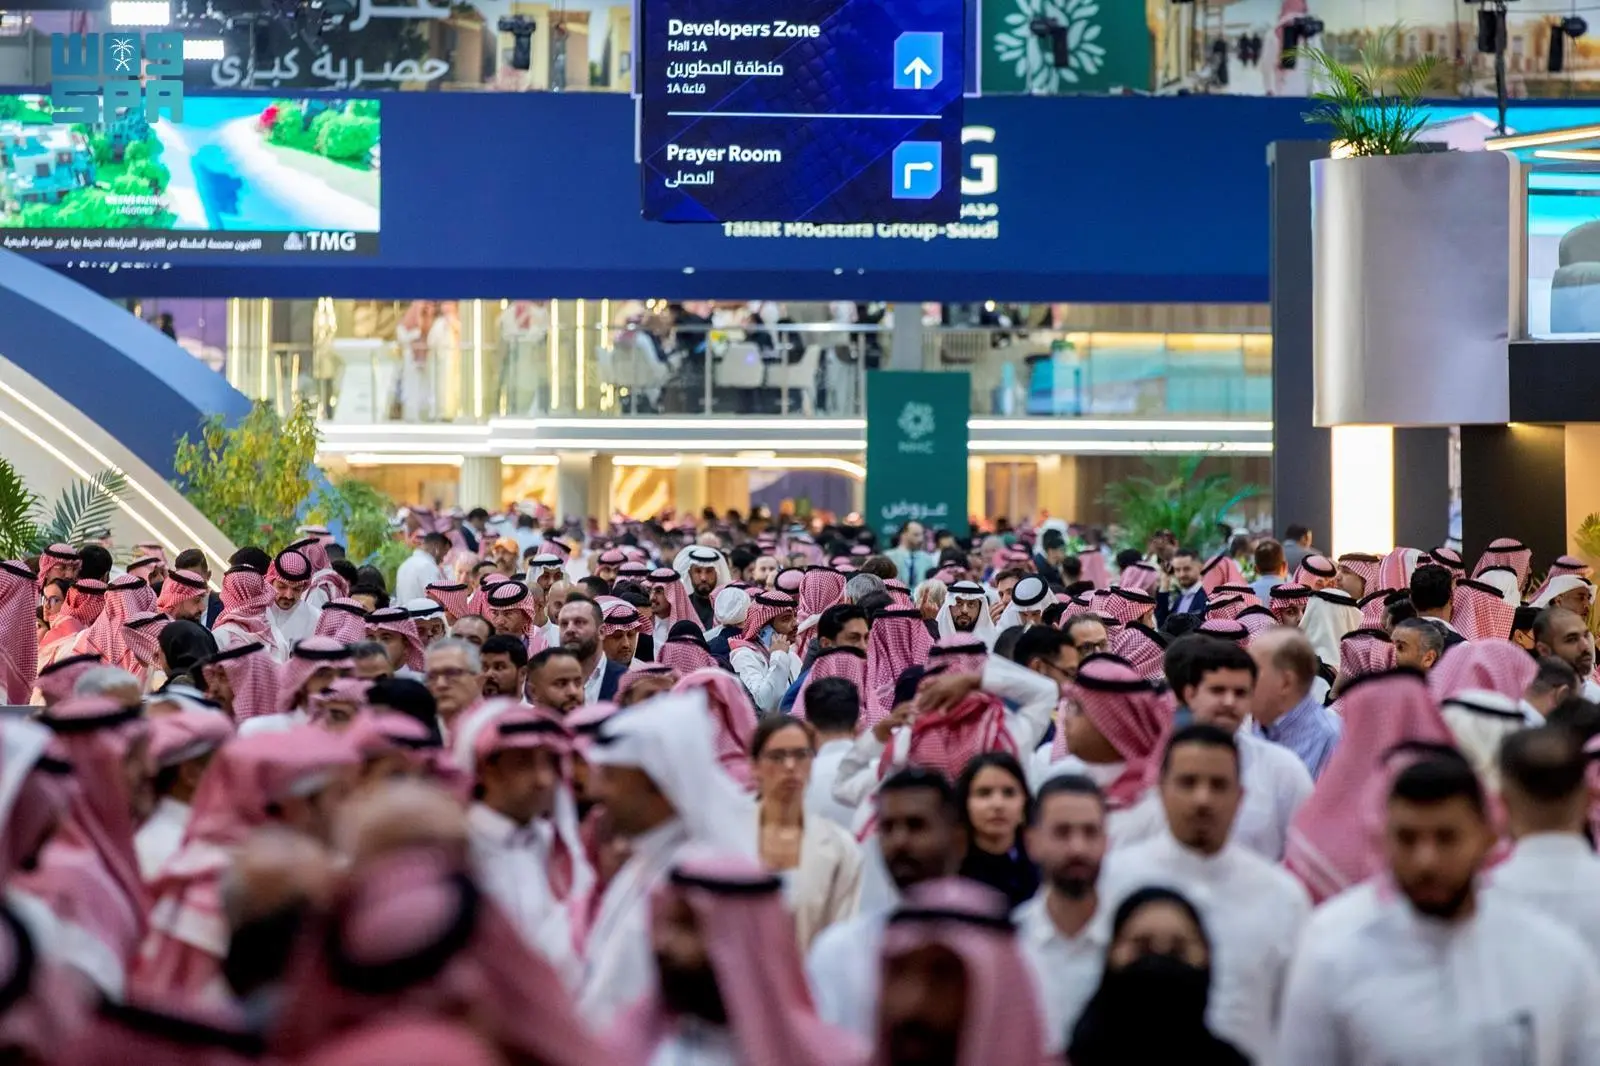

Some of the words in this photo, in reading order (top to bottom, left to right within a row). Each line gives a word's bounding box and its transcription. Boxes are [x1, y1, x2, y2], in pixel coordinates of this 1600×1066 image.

[668, 19, 771, 40] Developers
[773, 21, 821, 38] Zone
[667, 40, 690, 52] Hall
[692, 40, 708, 52] 1A
[666, 59, 731, 79] المطورين
[734, 60, 784, 76] منطقة
[667, 83, 681, 94] 1A
[682, 83, 706, 95] قاعة
[667, 144, 726, 166] Prayer
[728, 145, 782, 163] Room
[665, 170, 714, 188] المصلى
[306, 231, 356, 251] TMG
